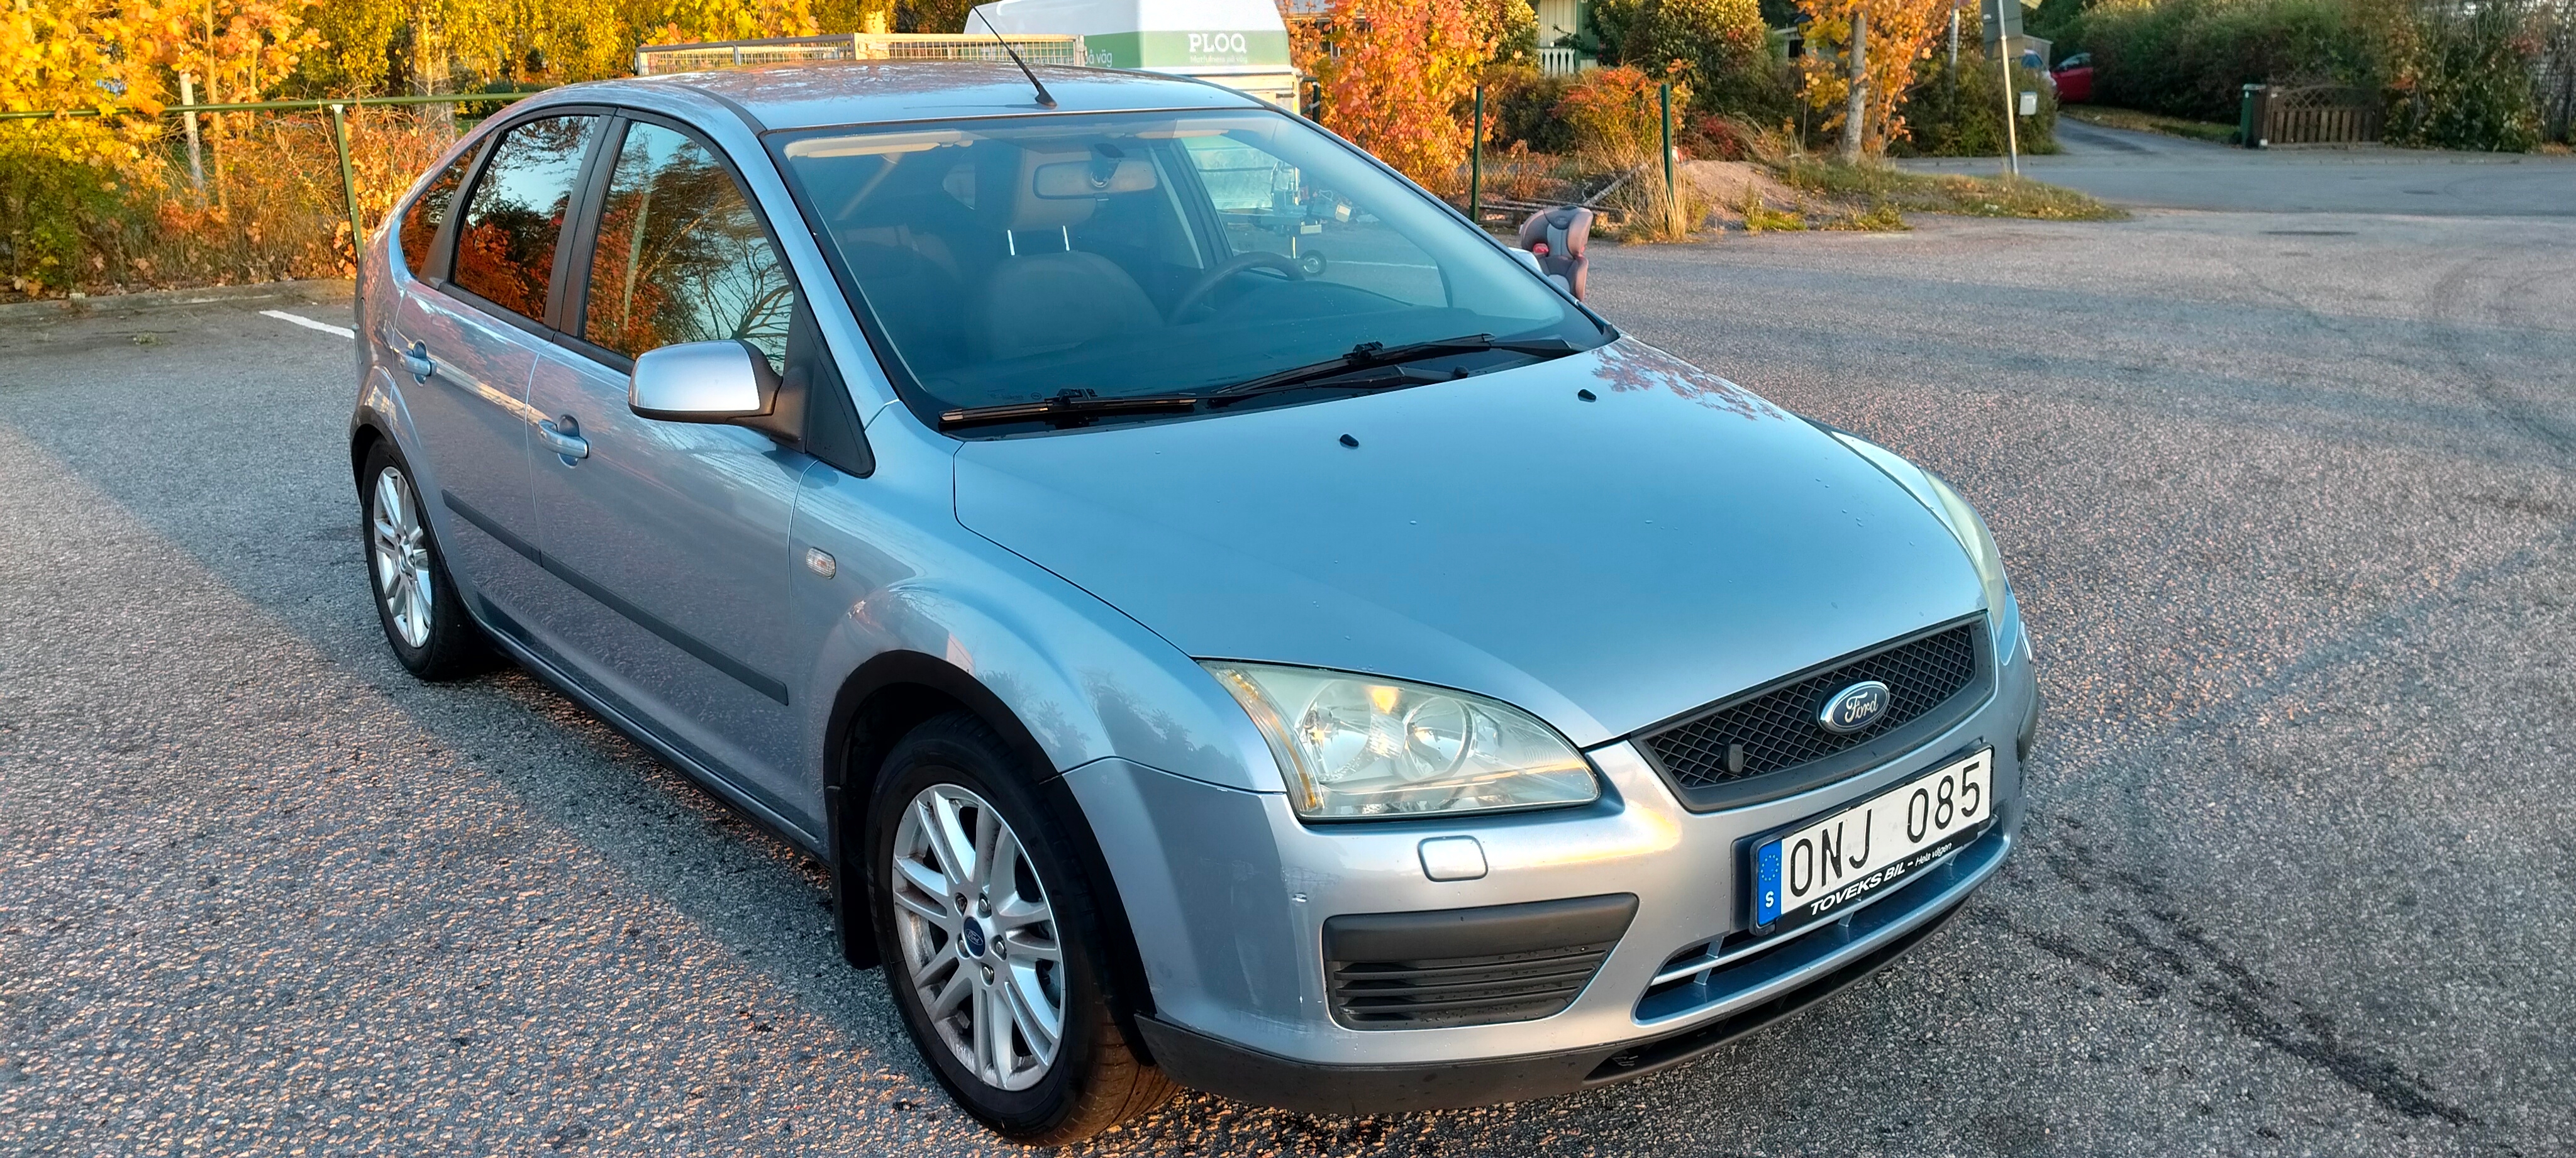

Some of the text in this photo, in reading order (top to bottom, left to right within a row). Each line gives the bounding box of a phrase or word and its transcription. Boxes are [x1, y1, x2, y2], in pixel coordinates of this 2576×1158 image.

[1188, 33, 1247, 53] PLOQ
[1085, 49, 1094, 65] å
[1096, 49, 1113, 67] väg
[1845, 692, 1879, 723] Ford
[1790, 761, 1980, 897] ONJ 085
[1765, 891, 1774, 908] S
[1811, 873, 1882, 915] TOVEKS
[1883, 862, 1906, 882] BIL
